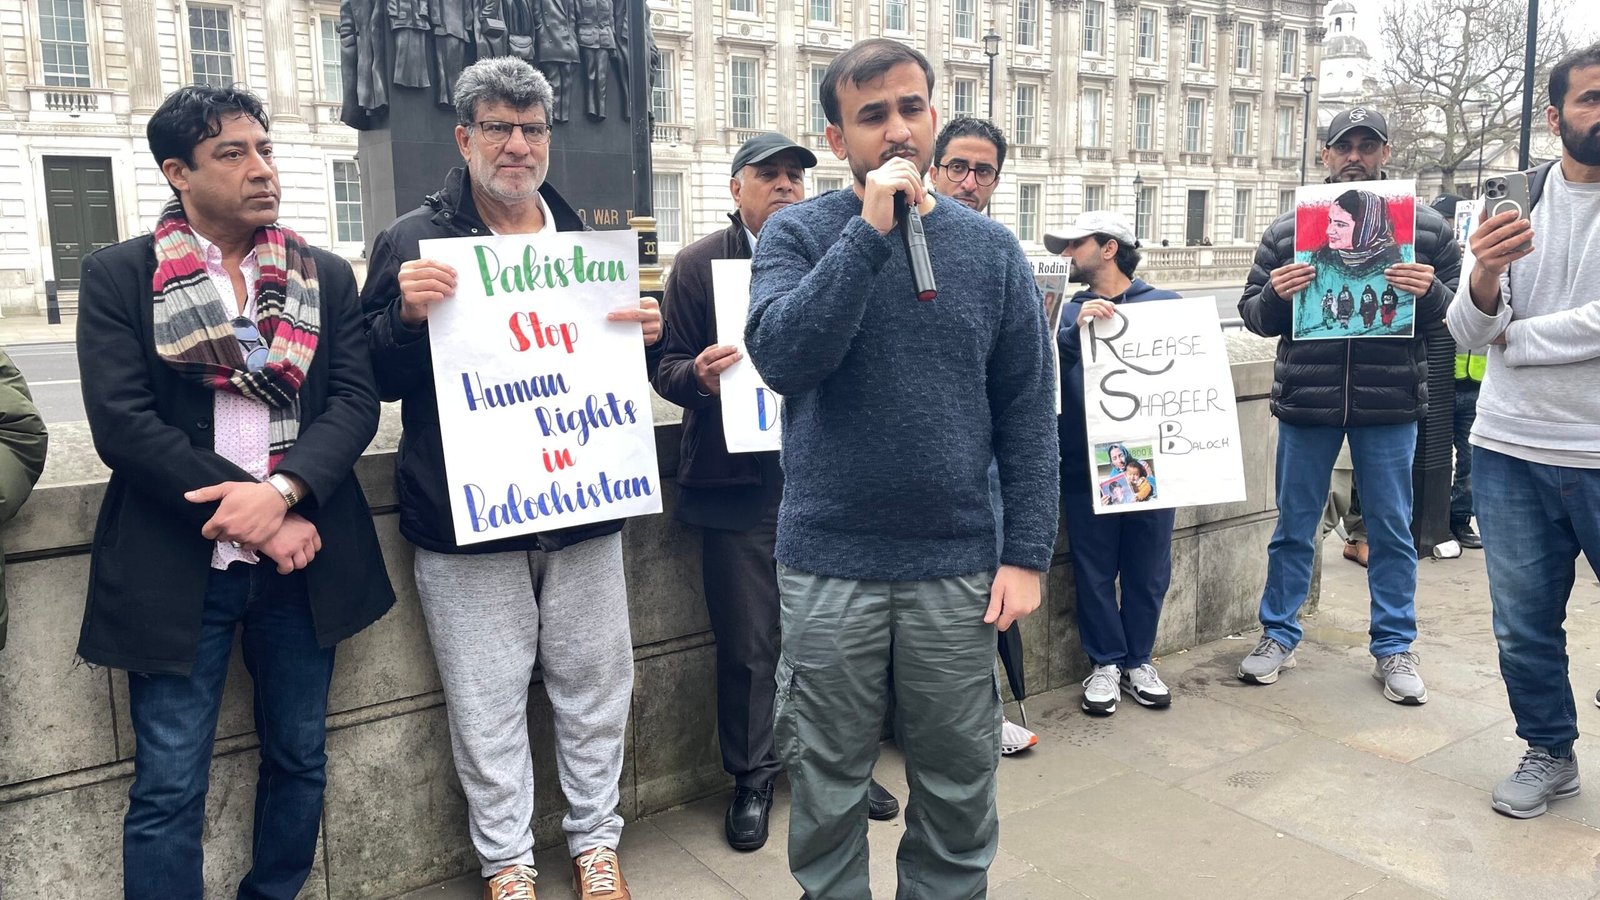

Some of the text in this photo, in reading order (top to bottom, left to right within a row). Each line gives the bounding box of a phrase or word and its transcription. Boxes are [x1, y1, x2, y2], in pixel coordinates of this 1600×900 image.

[593, 208, 619, 225] WAR
[474, 244, 629, 297] Pakistan
[1038, 261, 1068, 274] Rodini
[509, 311, 579, 354] Stop
[1089, 308, 1207, 376] RELEASE
[461, 371, 571, 412] Human
[1100, 369, 1226, 421] SHABEER
[535, 392, 638, 446] Rights
[1159, 420, 1229, 455] BALOCH
[542, 448, 576, 473] in
[463, 471, 655, 533] Balochistan
